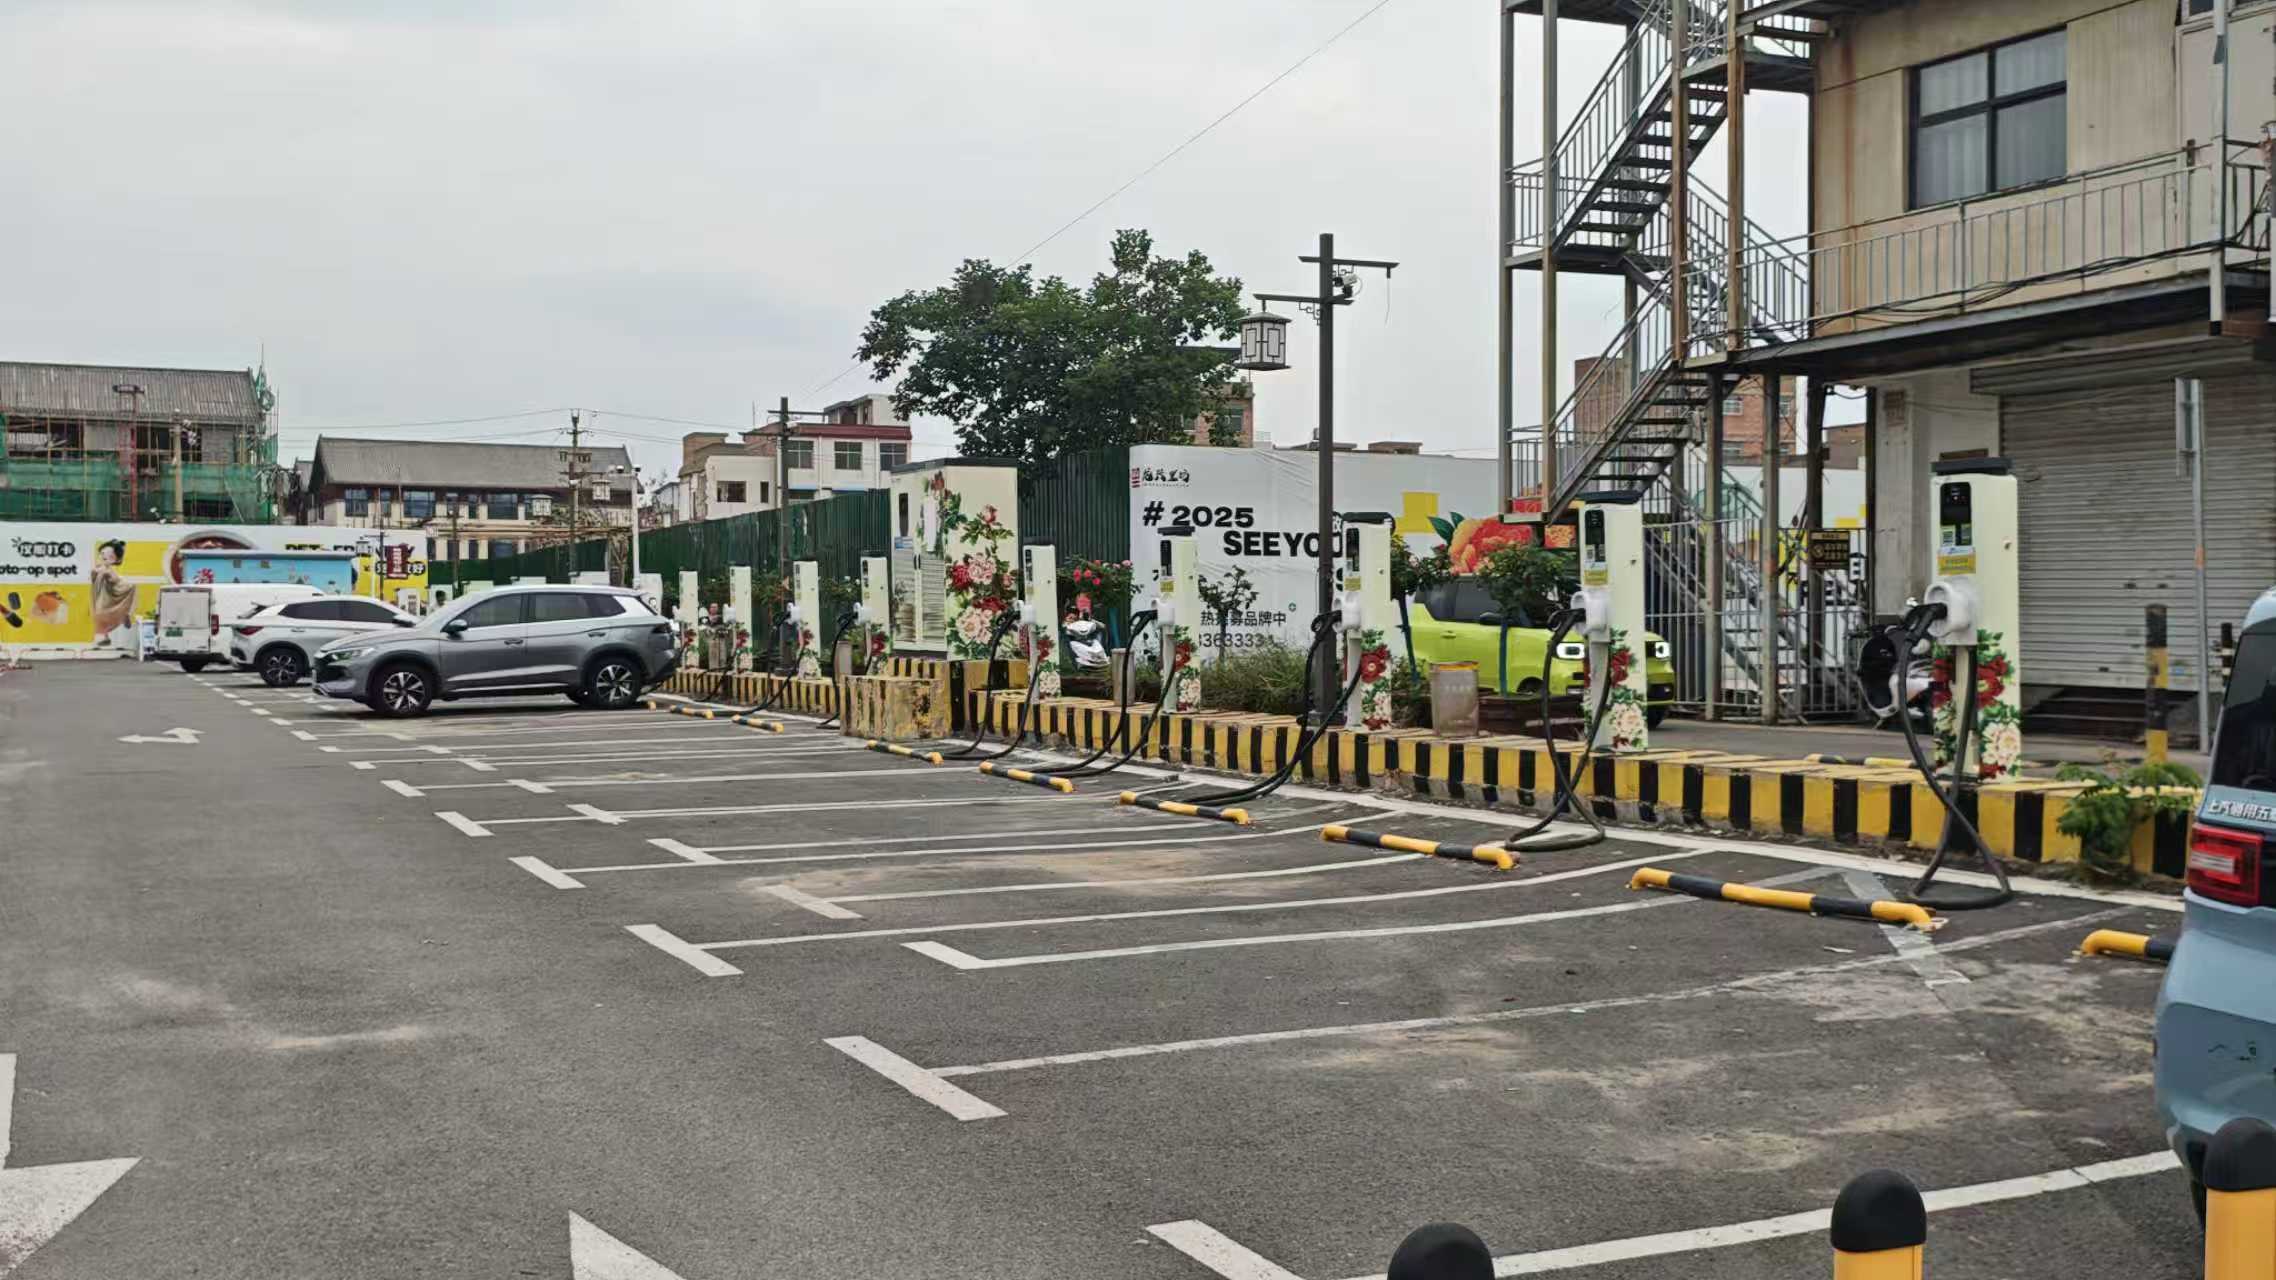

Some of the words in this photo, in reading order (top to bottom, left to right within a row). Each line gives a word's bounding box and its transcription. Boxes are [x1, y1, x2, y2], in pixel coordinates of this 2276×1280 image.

[1171, 505, 1254, 528] 2025
[47, 564, 77, 577] spot
[1200, 610, 1286, 628] 热募品牌中
